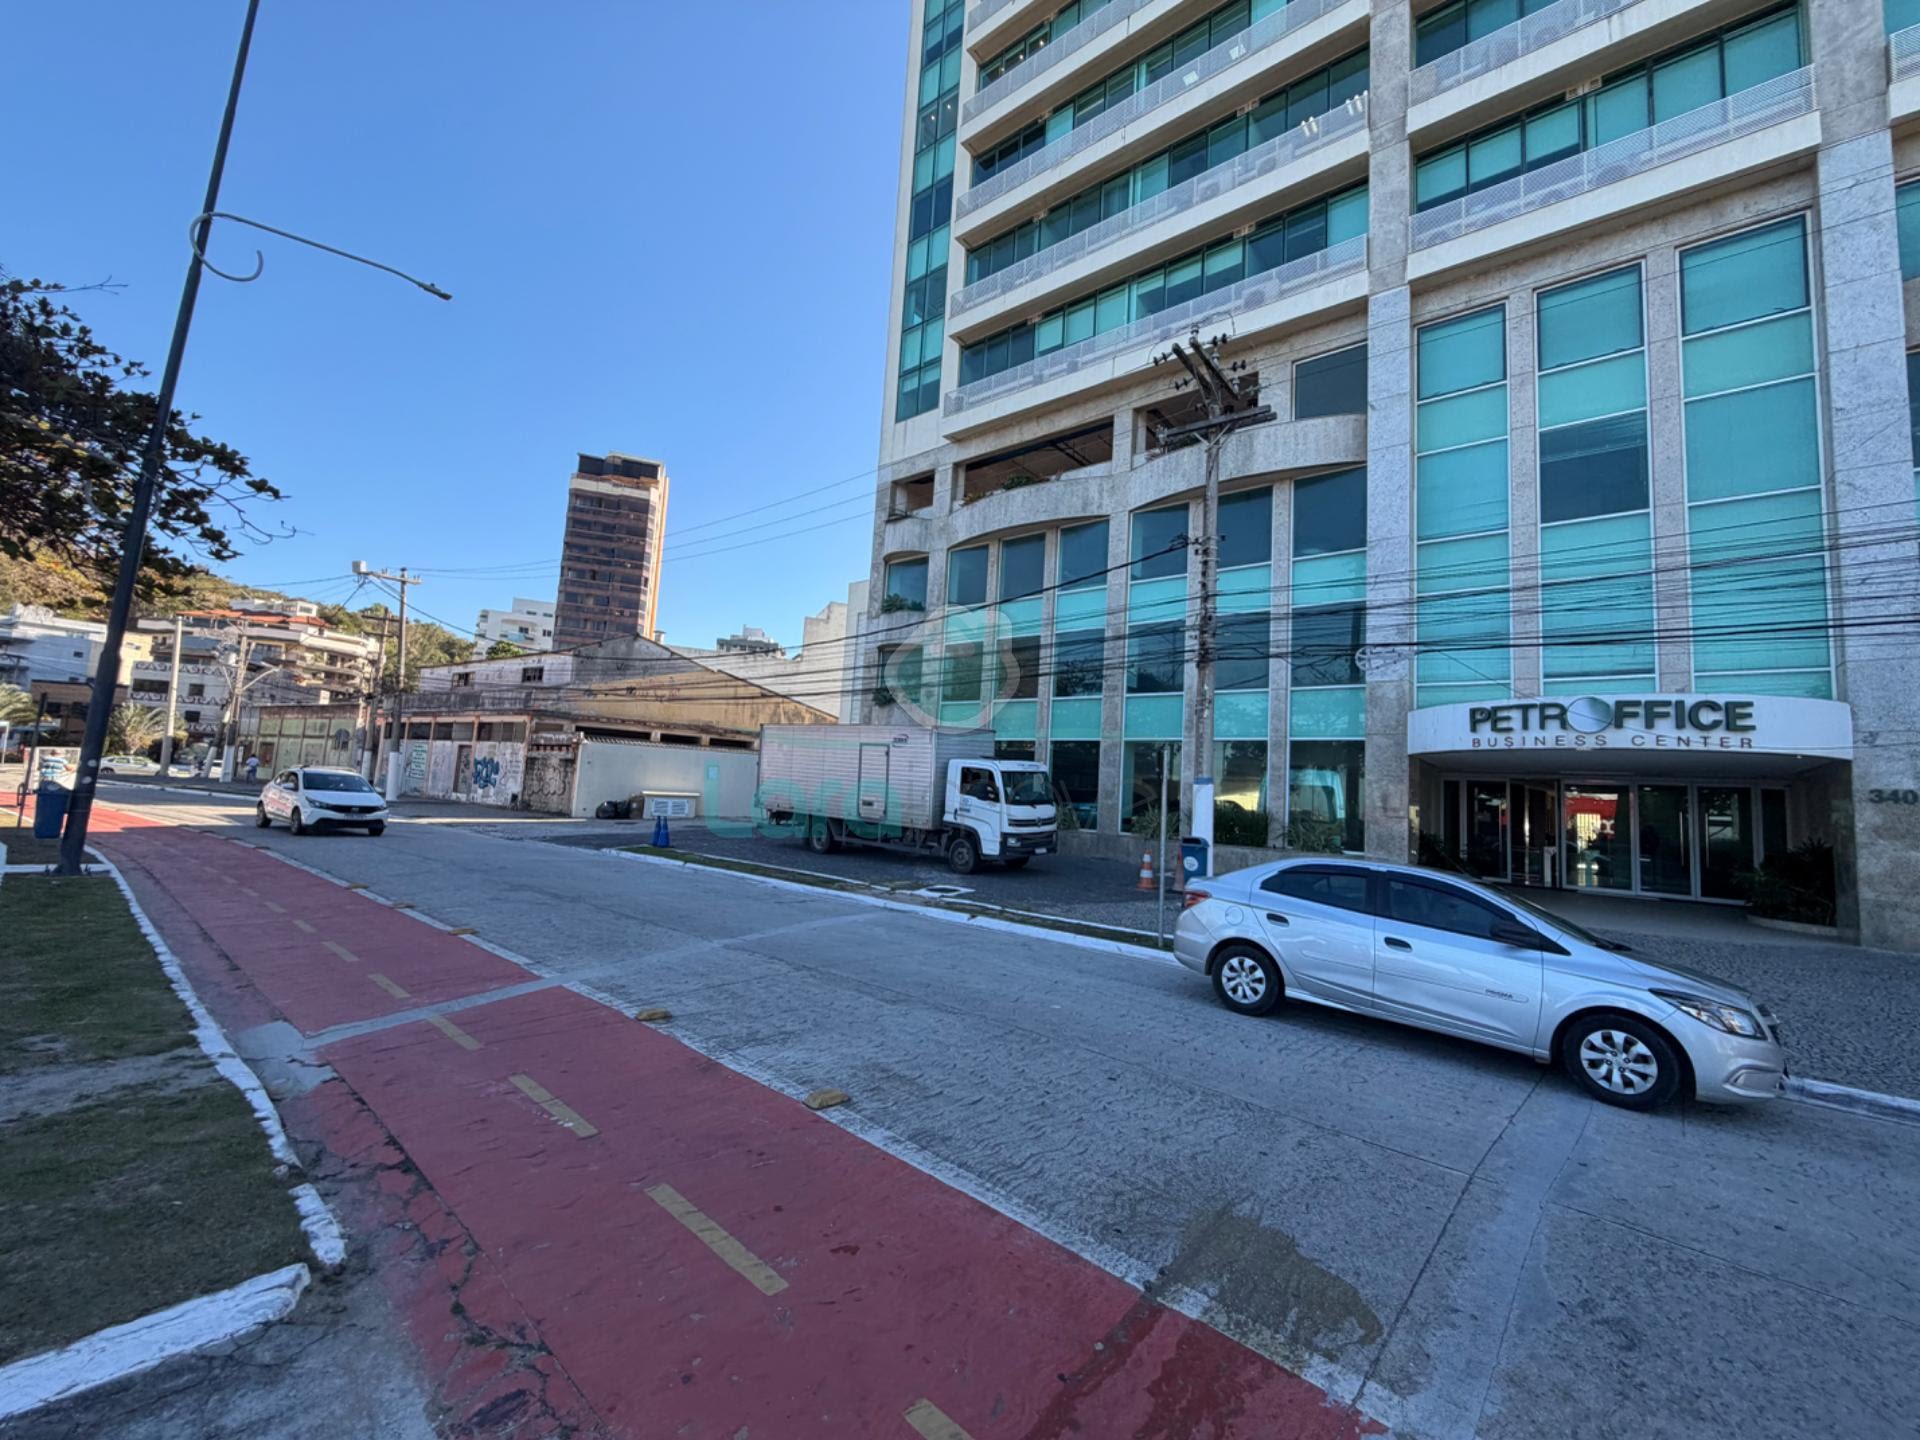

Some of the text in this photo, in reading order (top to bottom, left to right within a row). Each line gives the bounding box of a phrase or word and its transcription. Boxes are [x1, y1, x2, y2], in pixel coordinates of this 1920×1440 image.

[1472, 735, 1753, 750] BUSINESS CENTER
[1869, 789, 1919, 805] 340
